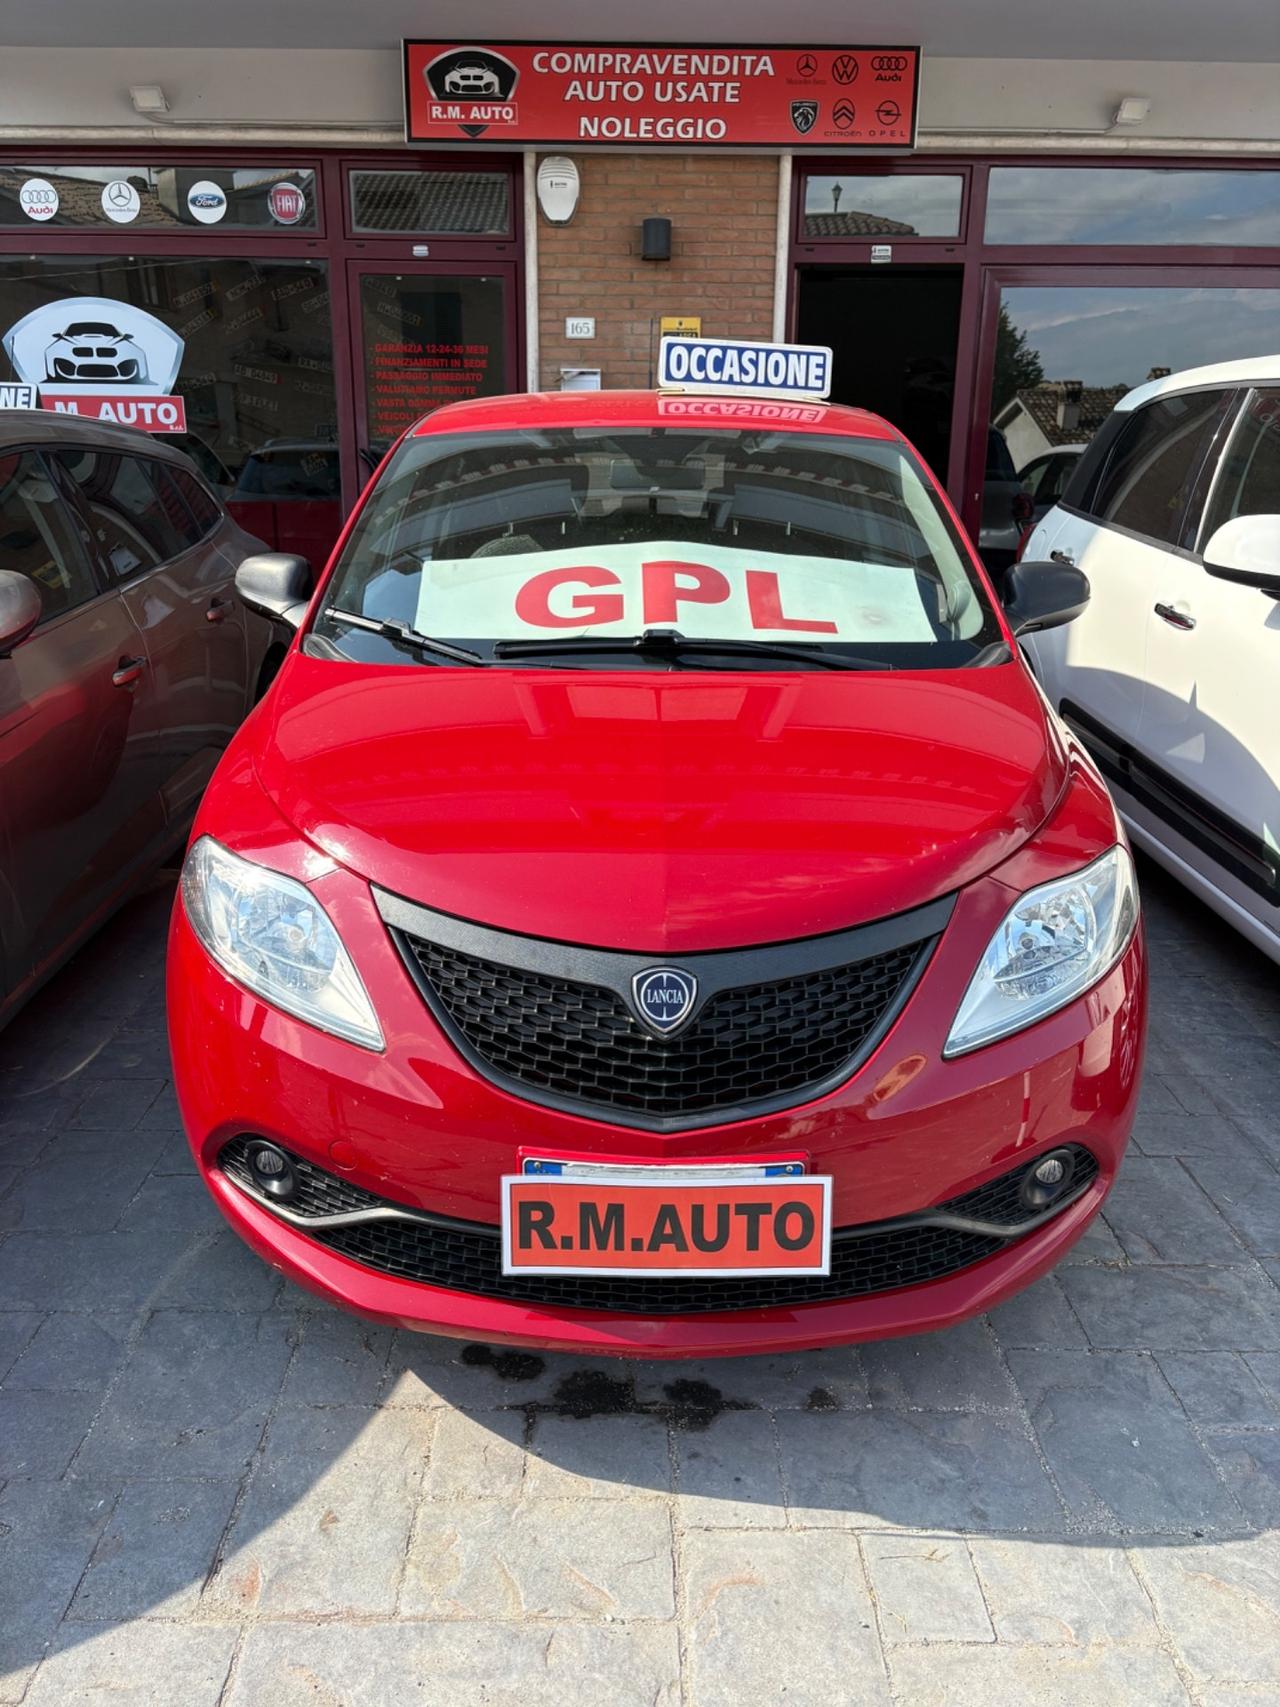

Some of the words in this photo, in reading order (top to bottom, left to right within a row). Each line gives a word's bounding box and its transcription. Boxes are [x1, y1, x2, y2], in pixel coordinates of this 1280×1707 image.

[532, 52, 775, 76] COMPRAVENDITA
[875, 73, 902, 82] Audi
[564, 80, 644, 102] AUTO
[654, 81, 741, 103] USATE
[431, 106, 465, 119] R.M.
[470, 106, 514, 120] AUTO
[579, 116, 727, 139] NOLEGGIO
[195, 195, 219, 206] Ford
[276, 194, 297, 212] FIAT
[28, 205, 54, 214] Audi
[571, 322, 590, 335] 165
[375, 344, 423, 353] GARANZIA
[375, 357, 449, 367] FINANZIAMENTI
[451, 358, 461, 367] IN
[463, 359, 488, 368] SEDE
[668, 345, 825, 388] OCCASIONE
[431, 372, 483, 382] IMMEDIATO
[98, 401, 178, 425] AUTO
[514, 560, 840, 635] GPL
[646, 988, 684, 1004] LANCIA
[518, 1201, 815, 1252] R.M.AUTO
